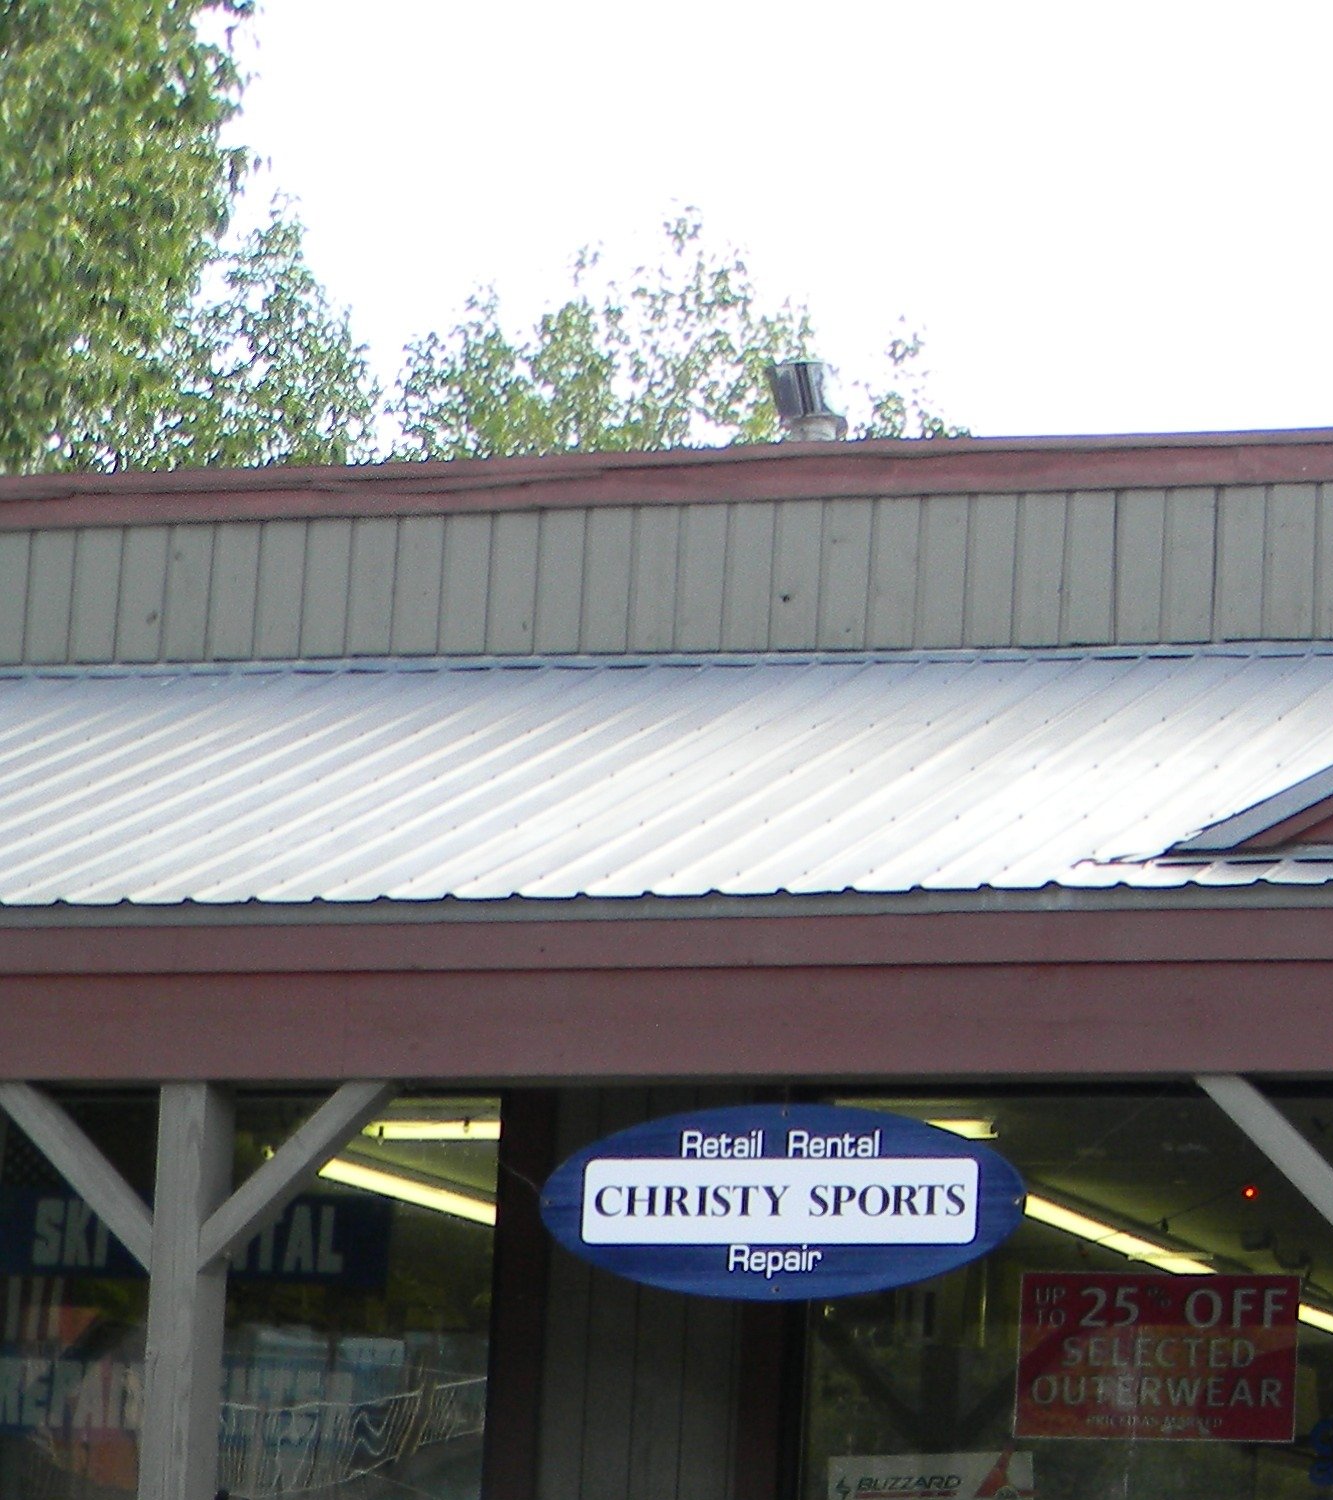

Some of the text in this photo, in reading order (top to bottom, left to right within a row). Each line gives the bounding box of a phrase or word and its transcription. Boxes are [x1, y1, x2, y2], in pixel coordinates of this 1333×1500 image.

[681, 1129, 881, 1159] Retail Rental
[593, 1183, 967, 1218] CHRISTY SPORTS
[728, 1244, 823, 1278] Repair
[1035, 1286, 1067, 1305] UP
[1184, 1287, 1289, 1330] OFF
[1062, 1335, 1256, 1369] SELECTED
[1030, 1374, 1283, 1408] OUTERWEAR
[856, 1475, 962, 1492] BLIZZARD
